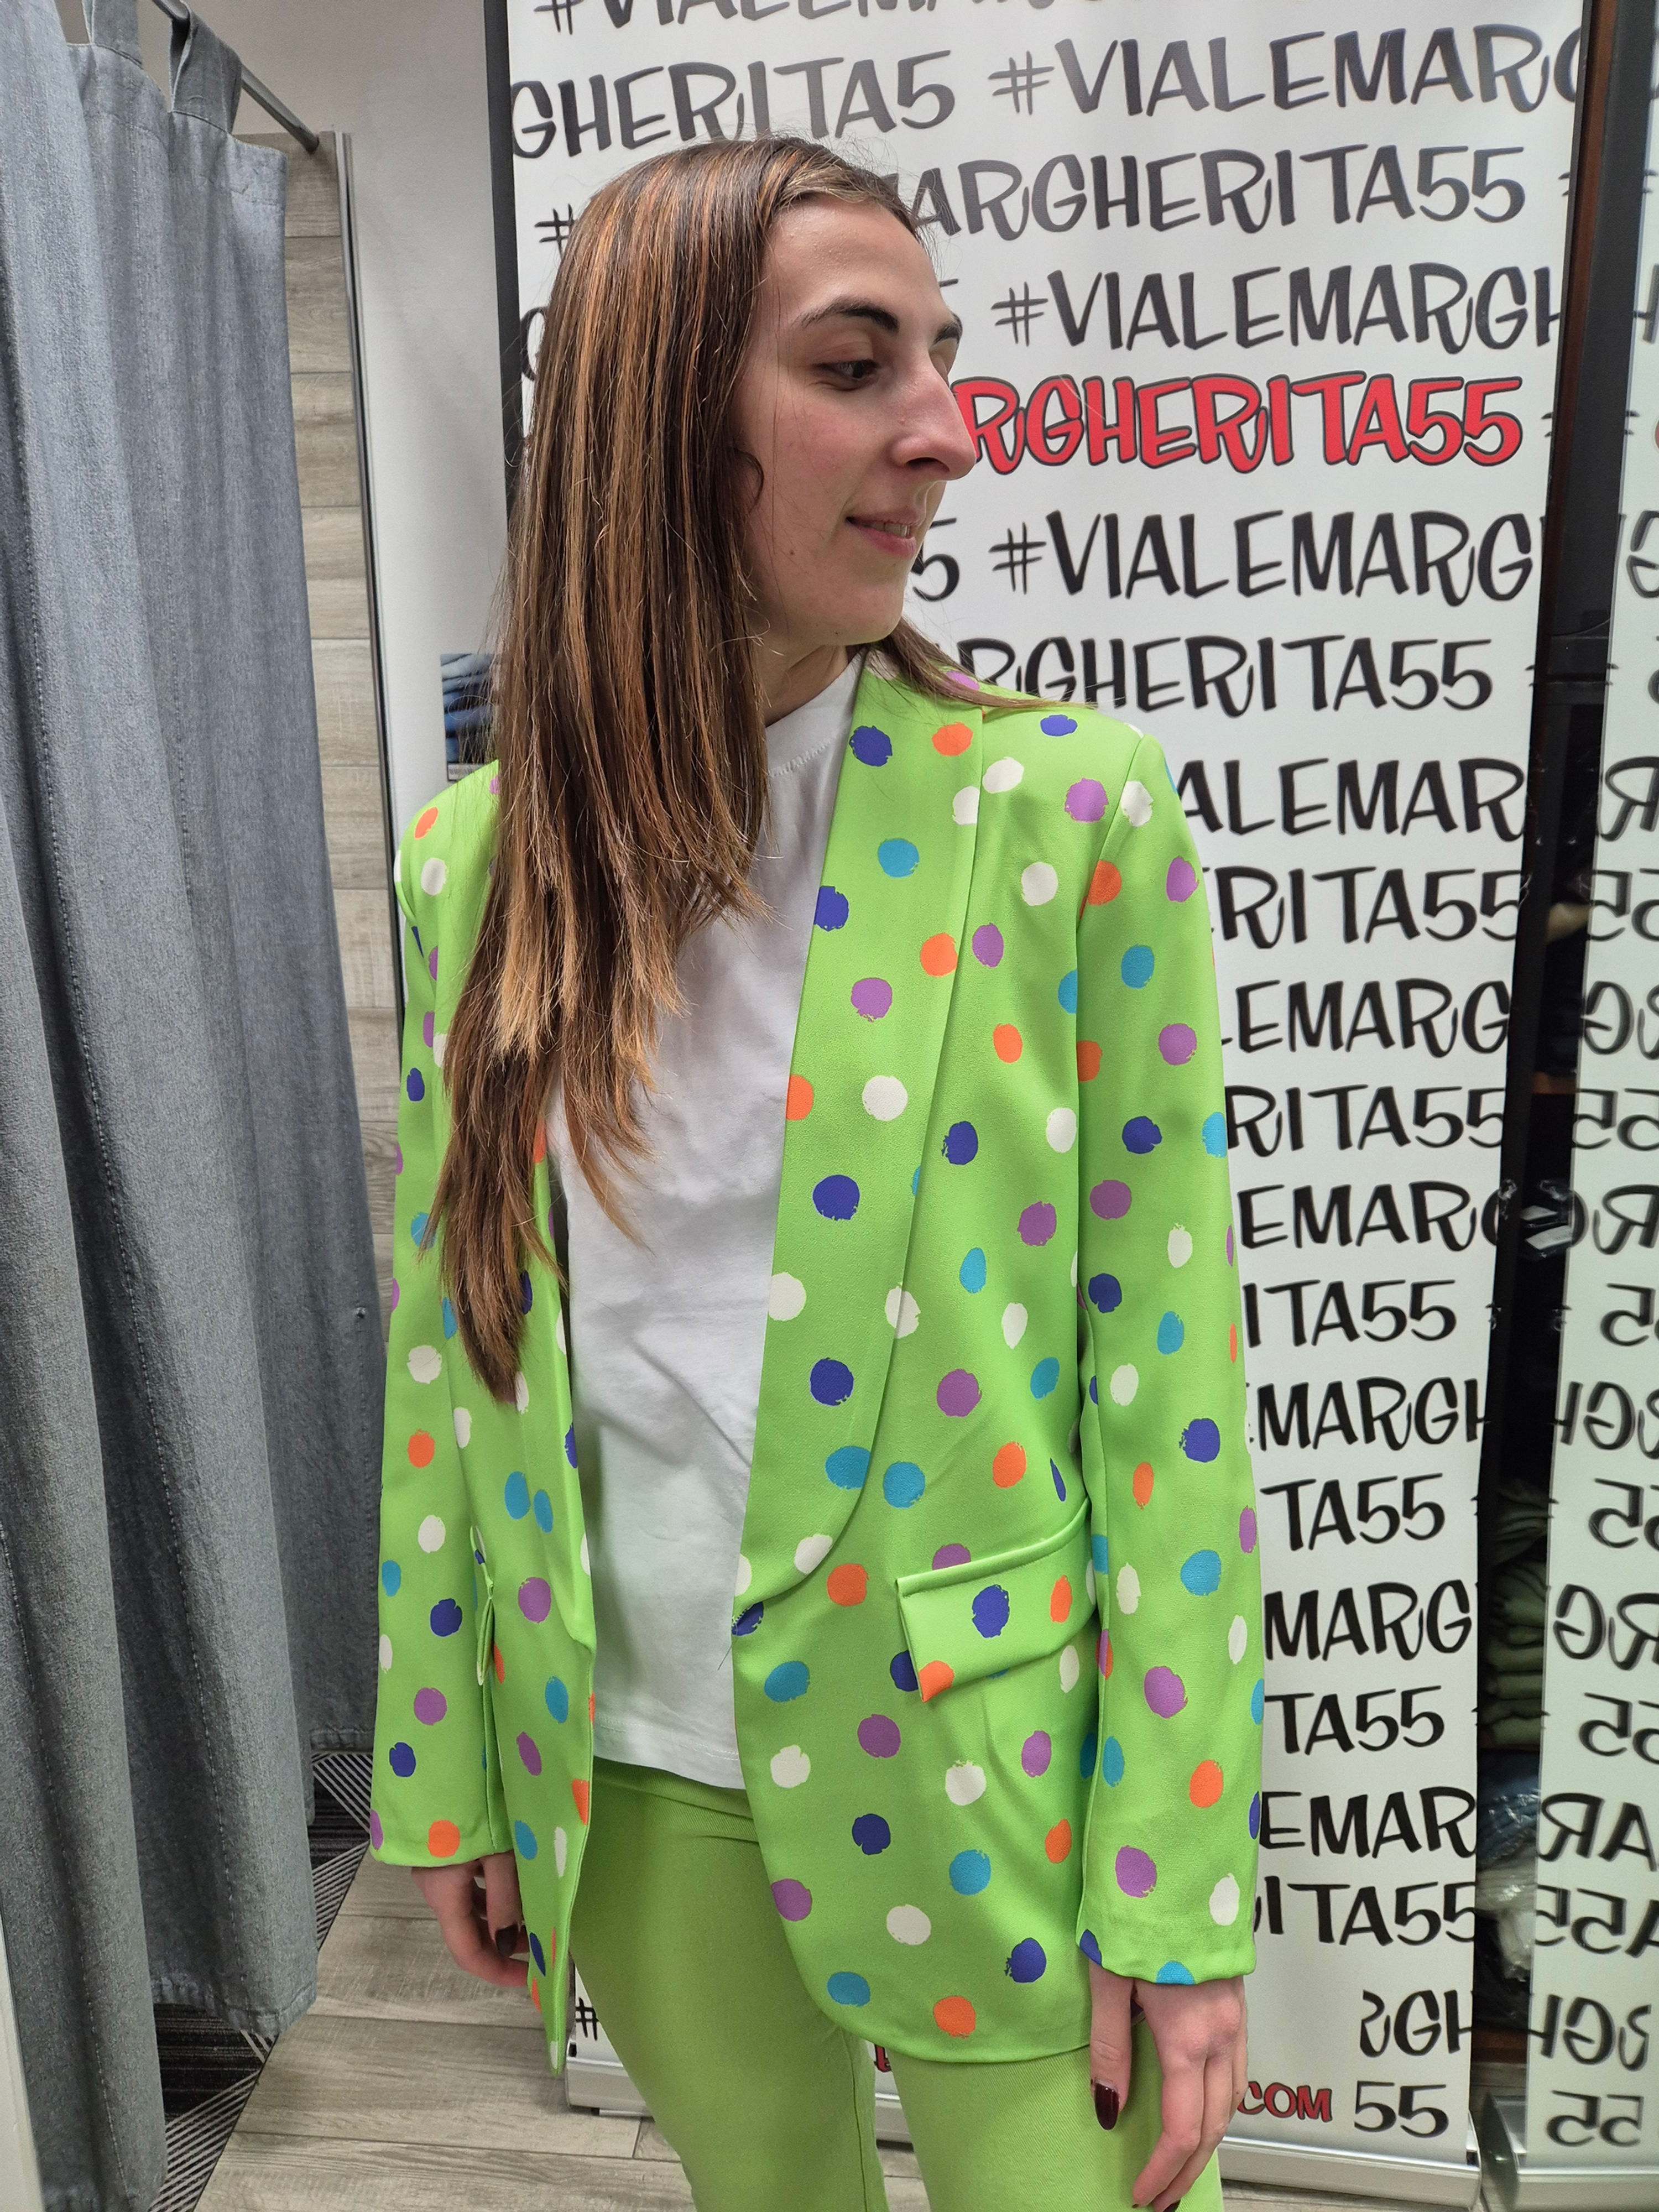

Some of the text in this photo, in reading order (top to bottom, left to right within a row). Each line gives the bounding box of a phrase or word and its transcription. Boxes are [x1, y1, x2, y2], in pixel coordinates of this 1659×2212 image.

[888, 144, 1526, 241] ARGHERITA55
[988, 510, 1546, 607] #VIALEMARG
[1202, 865, 1520, 950] RITA55
[1221, 978, 1511, 1058] EMARG
[1224, 1084, 1504, 1158] RITA55
[1242, 1279, 1457, 1348] ITA55
[1259, 1472, 1446, 1552] TA55
[1264, 1579, 1472, 1662] MARG
[1264, 1685, 1444, 1755] TA55
[1260, 1786, 1475, 1859] EMAR
[1253, 1876, 1475, 1946] ITA55
[1354, 2080, 1449, 2138] 55
